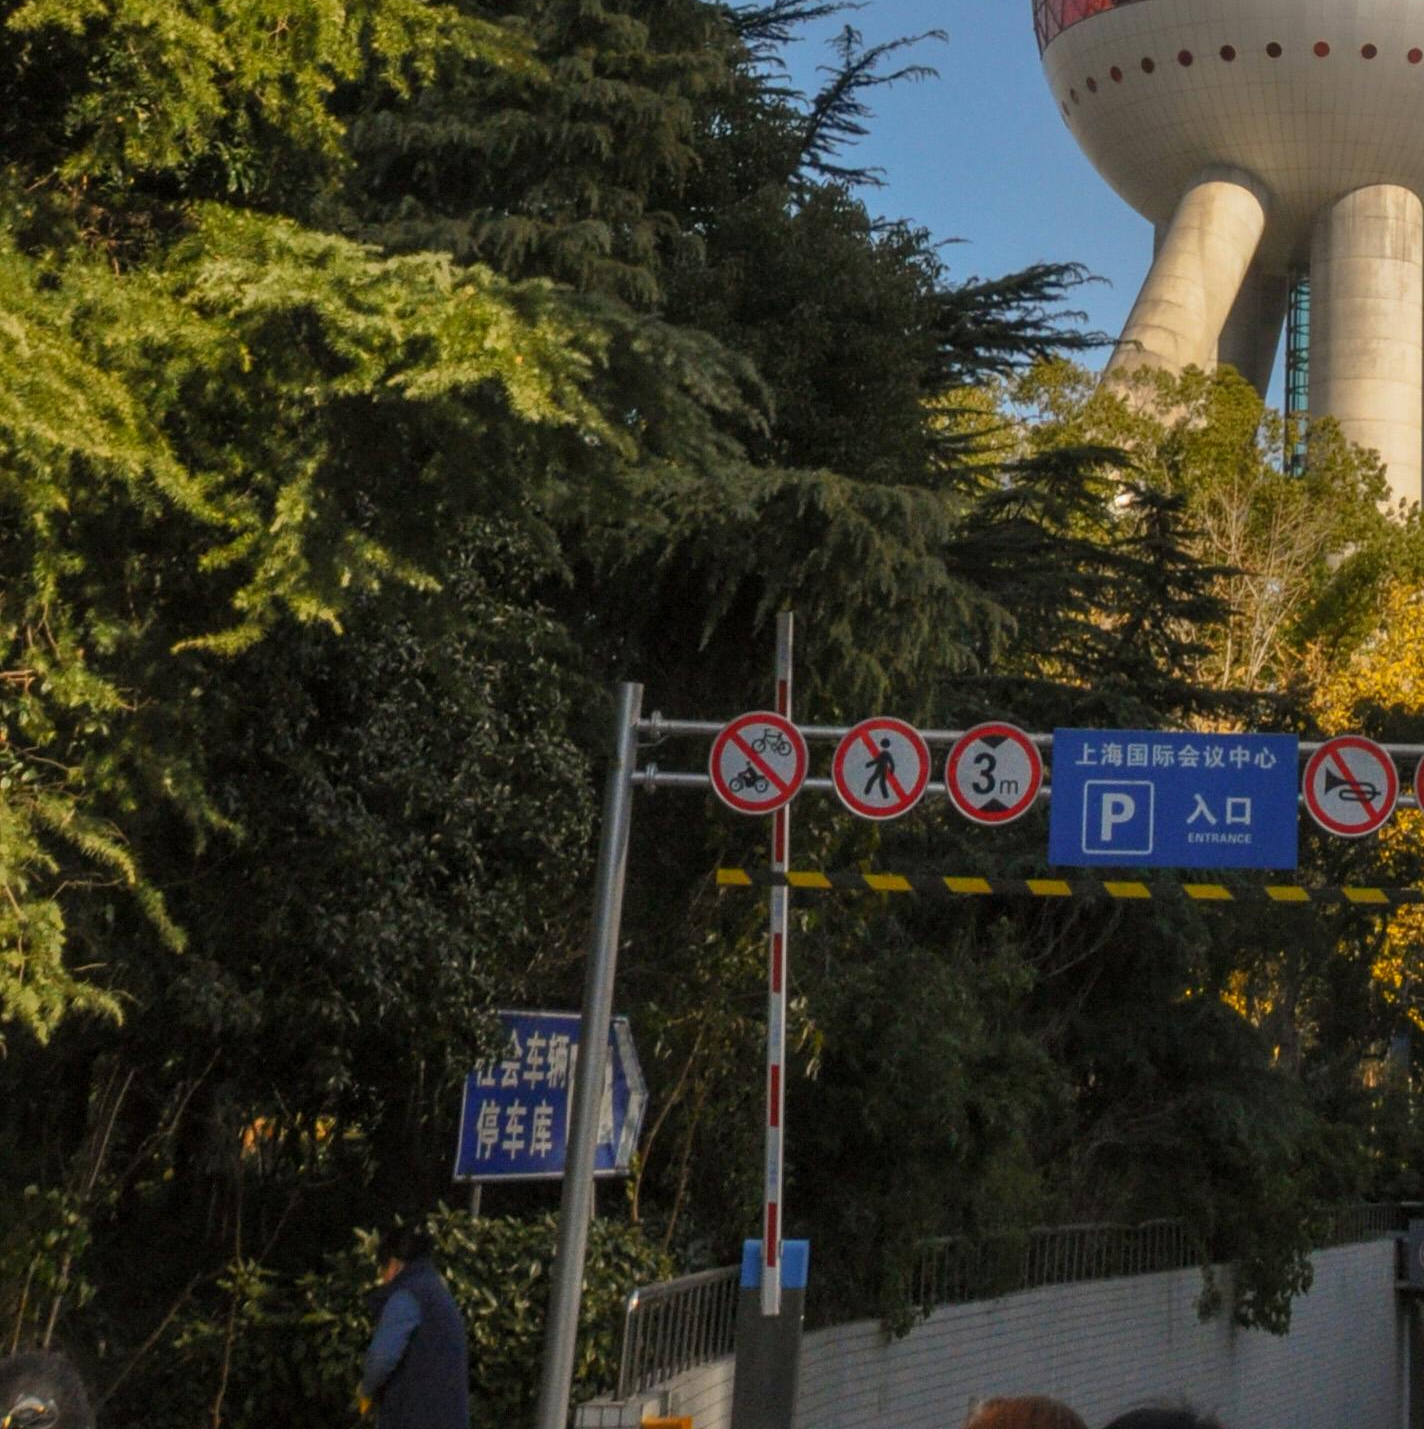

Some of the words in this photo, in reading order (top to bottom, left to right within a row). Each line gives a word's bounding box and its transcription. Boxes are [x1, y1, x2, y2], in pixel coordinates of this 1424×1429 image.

[1075, 743, 1277, 769] 上海国际会议中心
[1101, 793, 1135, 841] P
[1186, 794, 1251, 825] 入口
[1188, 832, 1252, 844] ENTRANCE
[476, 1098, 554, 1160] 停车库
